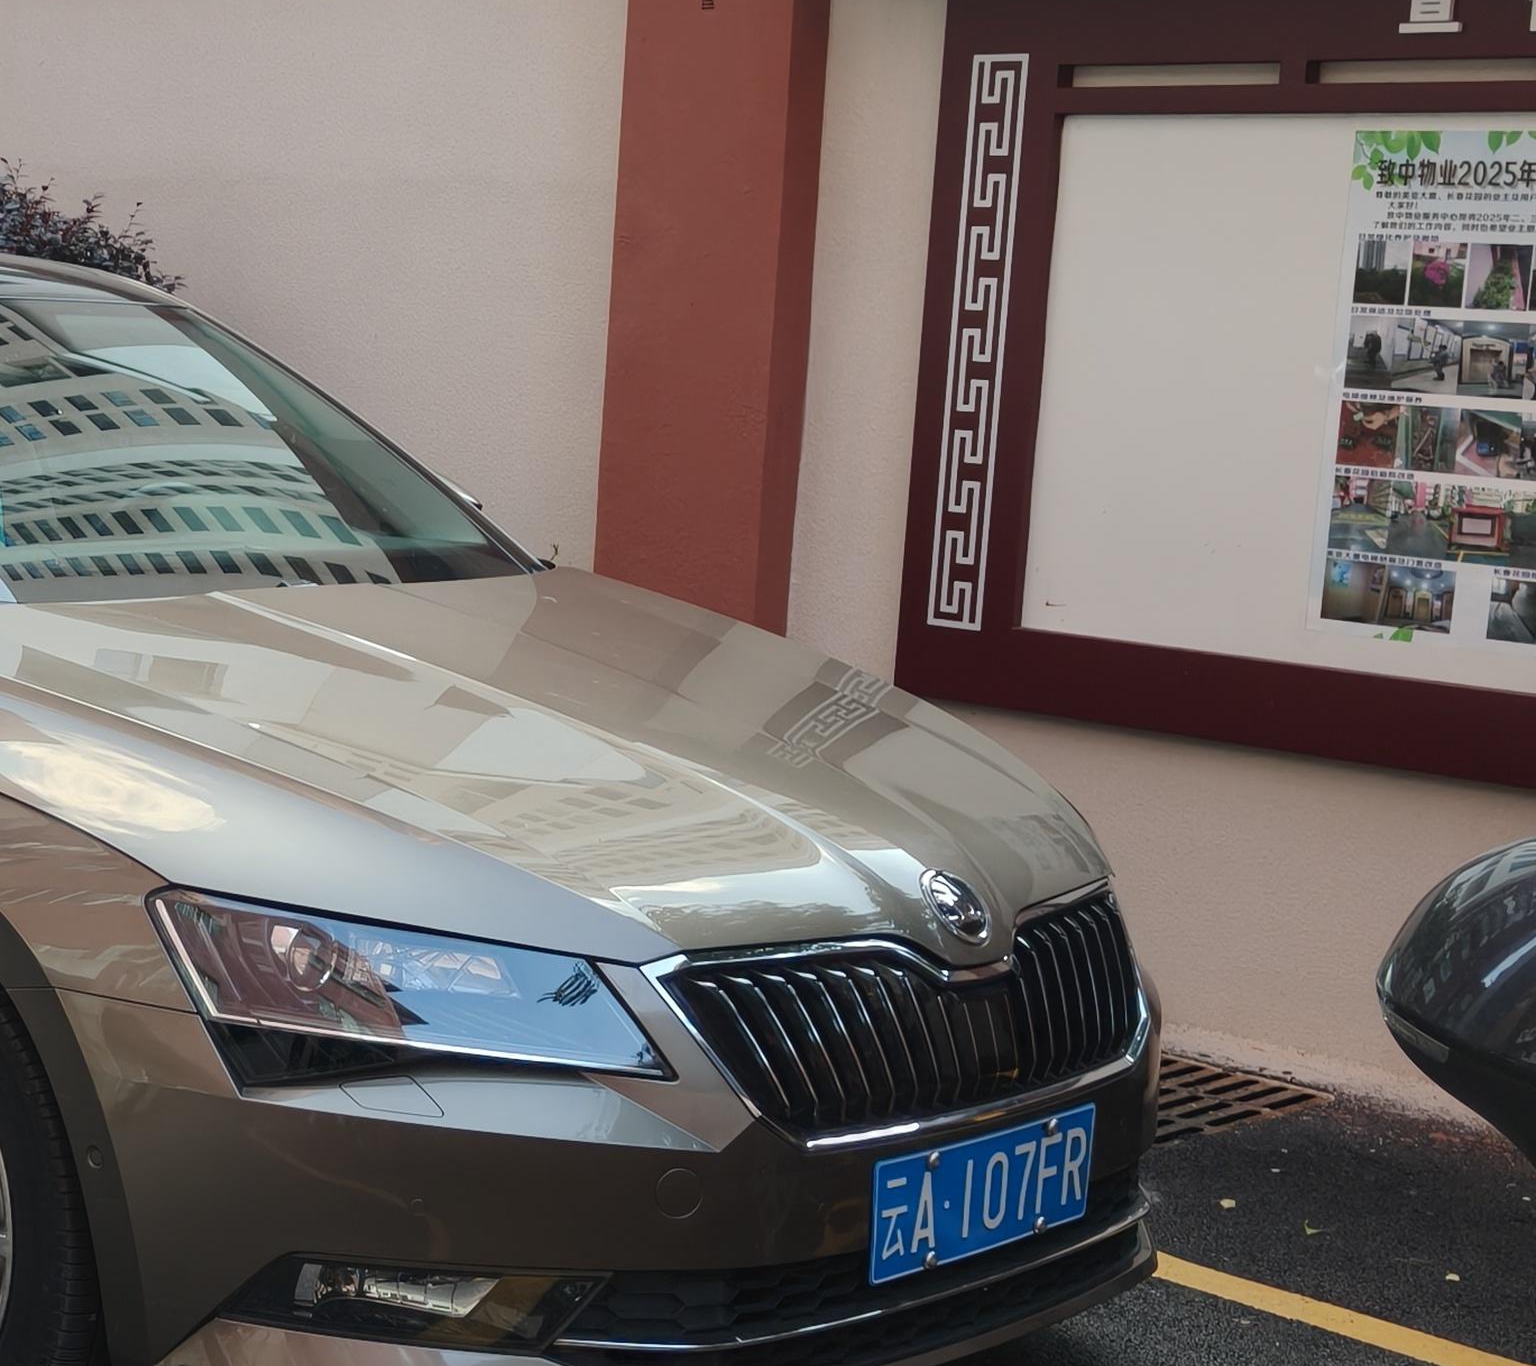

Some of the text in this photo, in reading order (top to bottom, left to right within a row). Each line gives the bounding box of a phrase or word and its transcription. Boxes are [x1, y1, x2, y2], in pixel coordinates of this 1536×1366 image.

[1376, 159, 1536, 188] 致中物业2025年
